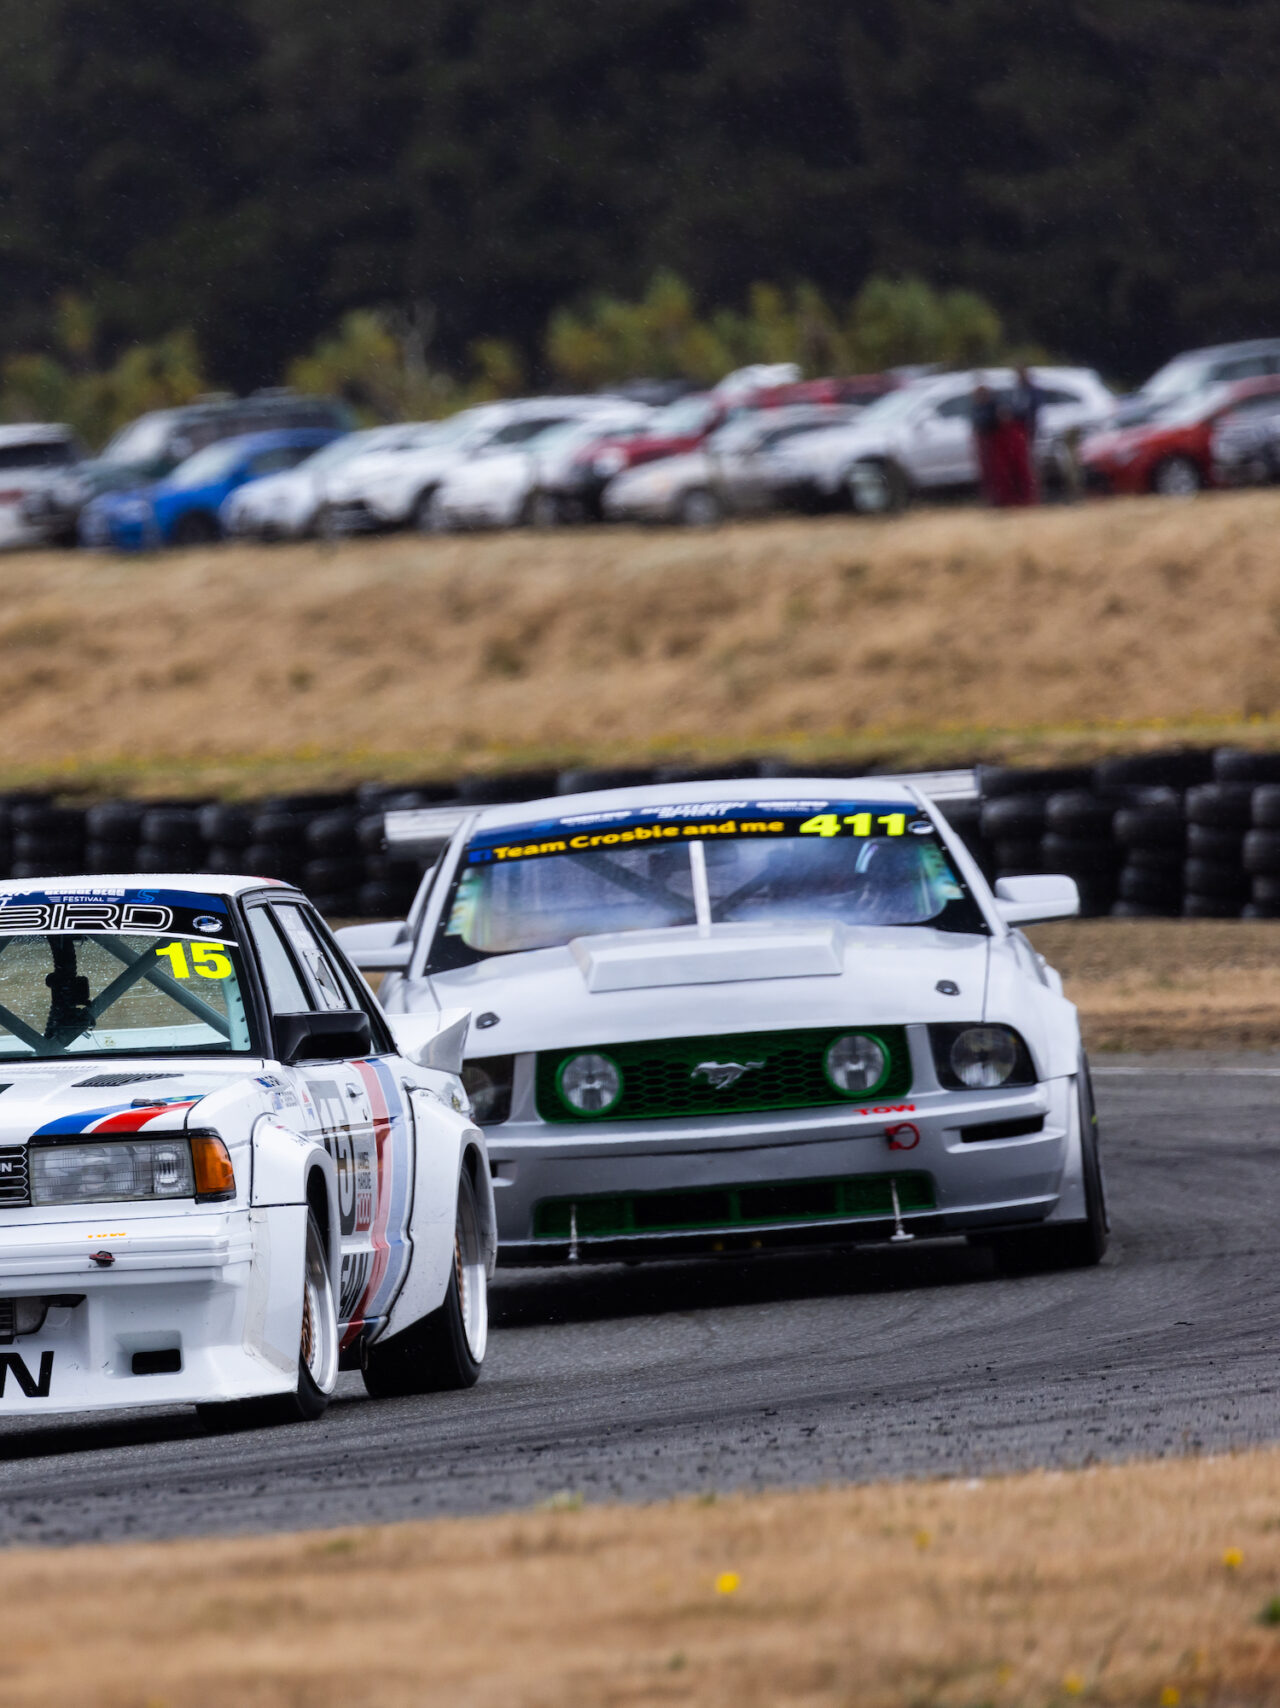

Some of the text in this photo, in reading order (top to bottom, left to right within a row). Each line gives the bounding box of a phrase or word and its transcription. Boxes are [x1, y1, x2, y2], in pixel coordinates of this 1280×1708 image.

[799, 813, 906, 837] 411
[493, 821, 784, 860] Team Crosbie and me
[62, 895, 105, 903] FESTIVAL
[155, 942, 232, 979] 15
[852, 1104, 917, 1115] TOW
